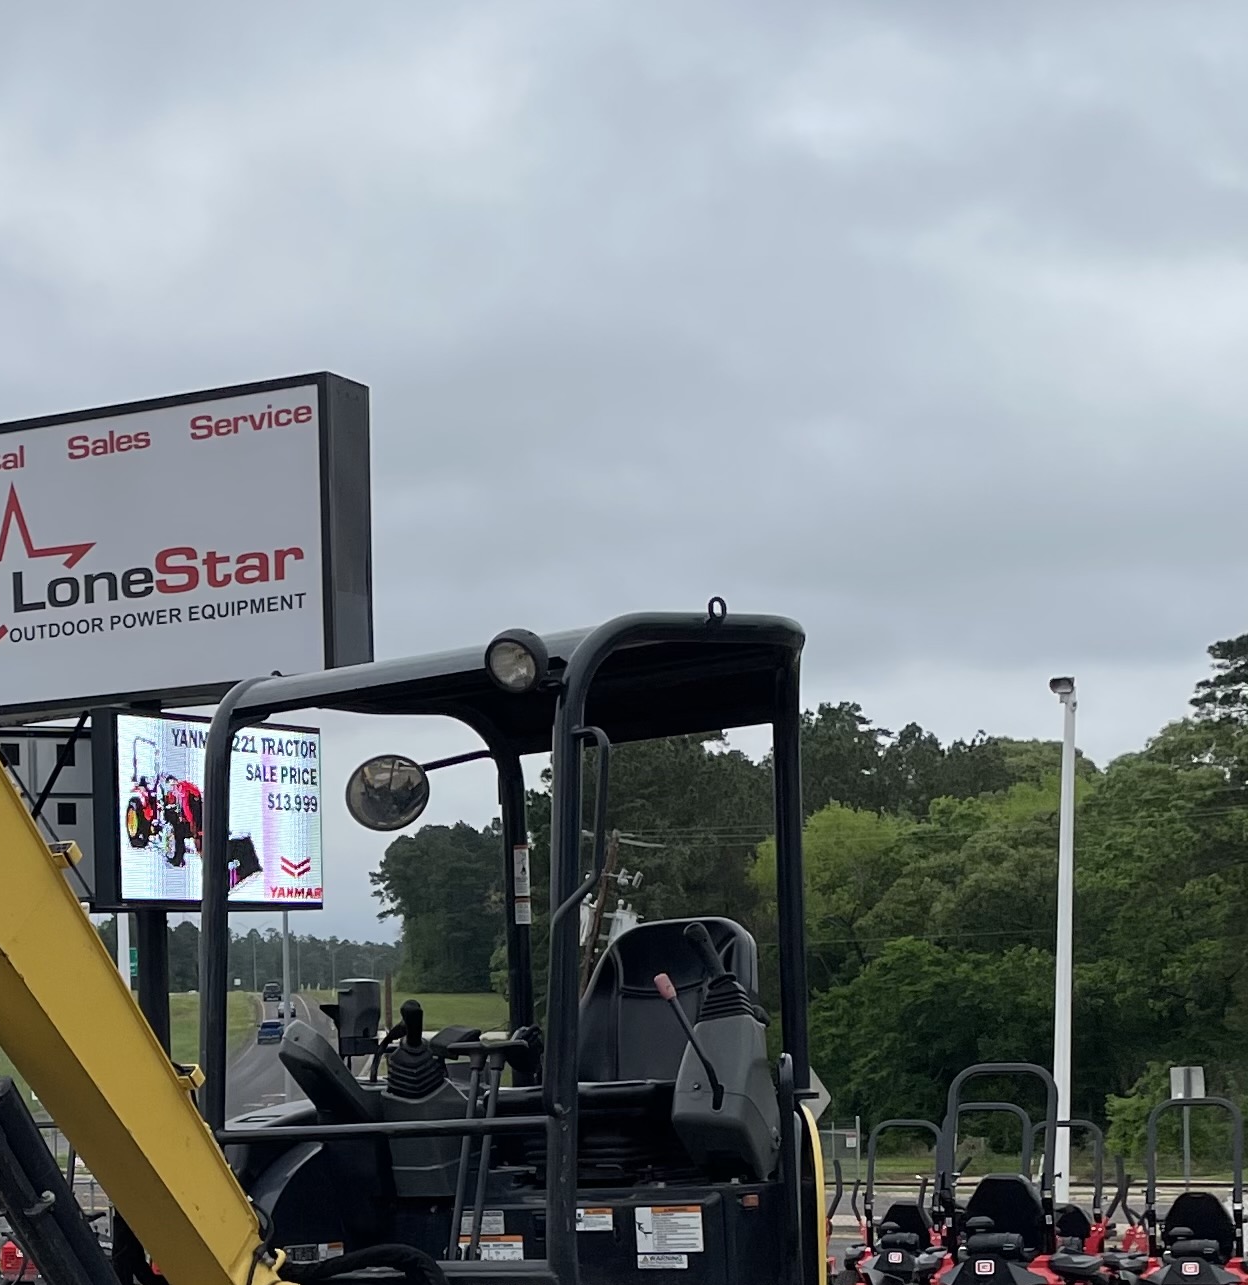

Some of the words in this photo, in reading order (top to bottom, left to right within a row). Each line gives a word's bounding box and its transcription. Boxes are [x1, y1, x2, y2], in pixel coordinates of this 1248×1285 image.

[67, 430, 151, 460] Sales
[189, 404, 313, 441] Service
[12, 547, 304, 613] LoneStar
[9, 617, 104, 643] OUTDOOR
[110, 607, 182, 631] POWER
[188, 592, 307, 621] EQUIPMENT
[261, 737, 317, 759] TRACTOR
[245, 763, 278, 783] SALE
[280, 766, 318, 786] PRICE
[270, 886, 323, 900] YANMAR
